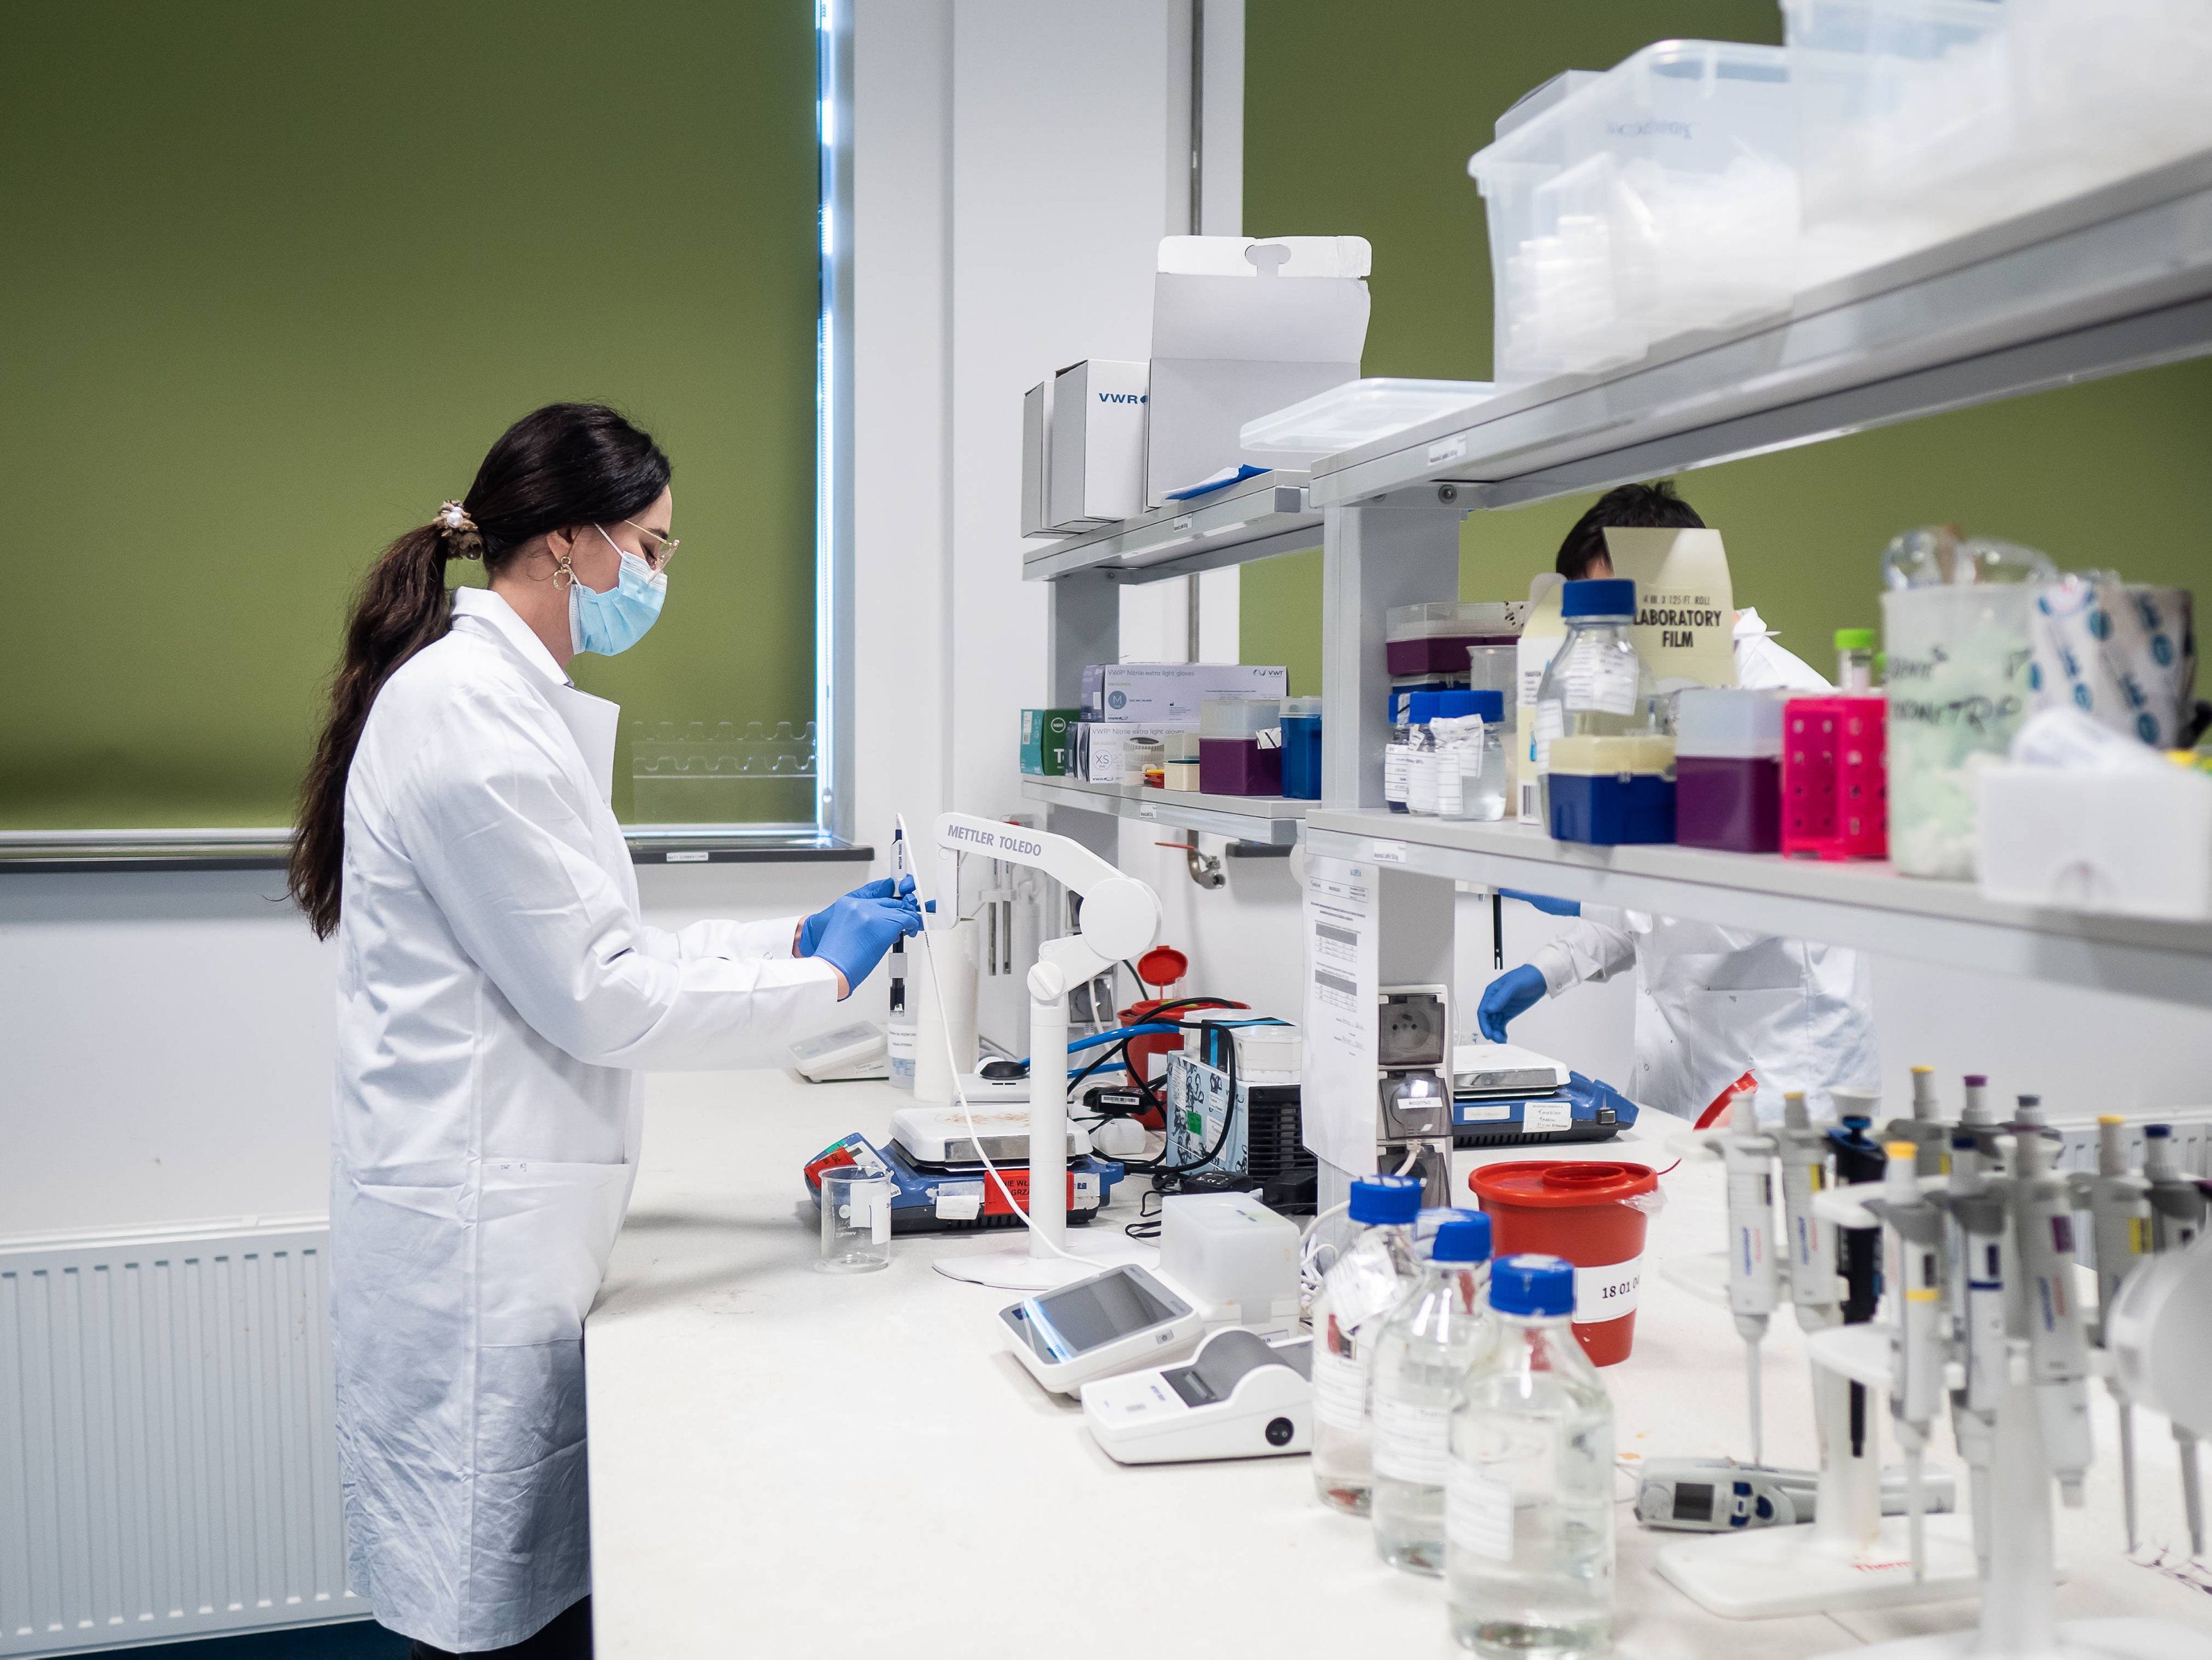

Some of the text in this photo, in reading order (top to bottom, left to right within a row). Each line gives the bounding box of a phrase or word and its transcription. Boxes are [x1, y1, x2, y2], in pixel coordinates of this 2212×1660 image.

[1098, 393, 1138, 404] VWR
[1670, 595, 1681, 604] 125
[1695, 596, 1710, 605] ROLL
[1634, 609, 1722, 626] LABORATORY
[1662, 630, 1694, 648] FILM
[1114, 695, 1122, 704] M
[1095, 755, 1109, 764] XS
[948, 824, 1042, 857] METTLER TOLEDO
[1602, 1286, 1617, 1298] 18
[1619, 1281, 1631, 1295] 01
